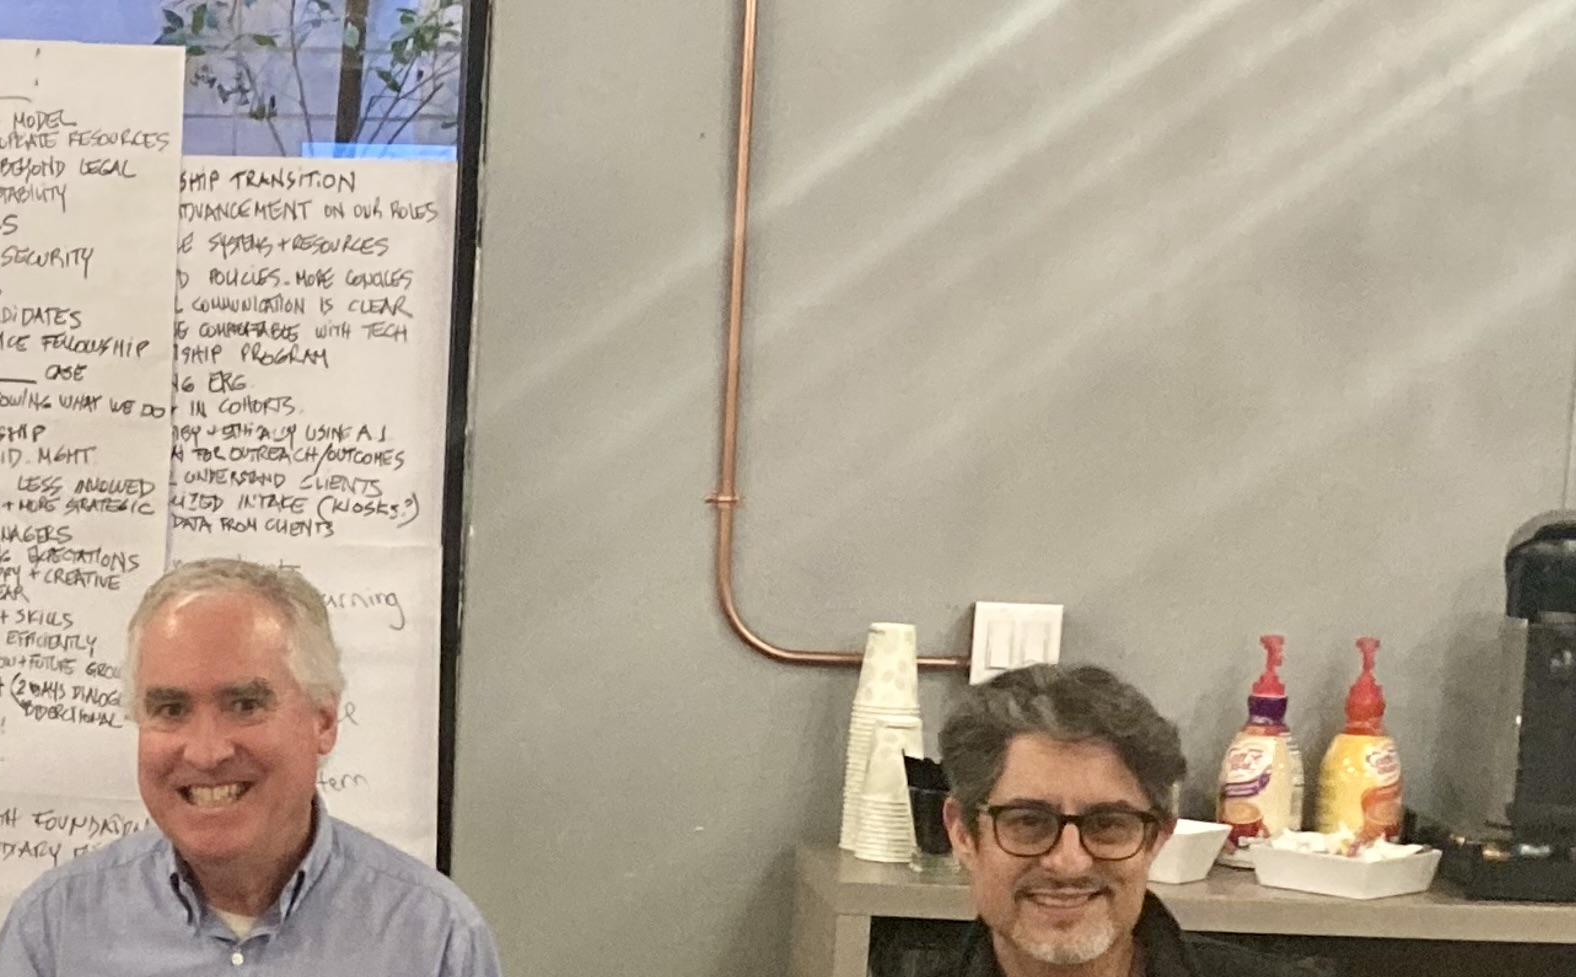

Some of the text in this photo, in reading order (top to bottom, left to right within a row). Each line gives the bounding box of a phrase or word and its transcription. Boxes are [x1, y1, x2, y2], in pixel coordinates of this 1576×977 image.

[229, 169, 355, 192] TRANSITION
[325, 202, 345, 218] ON
[361, 322, 407, 342] TECH
